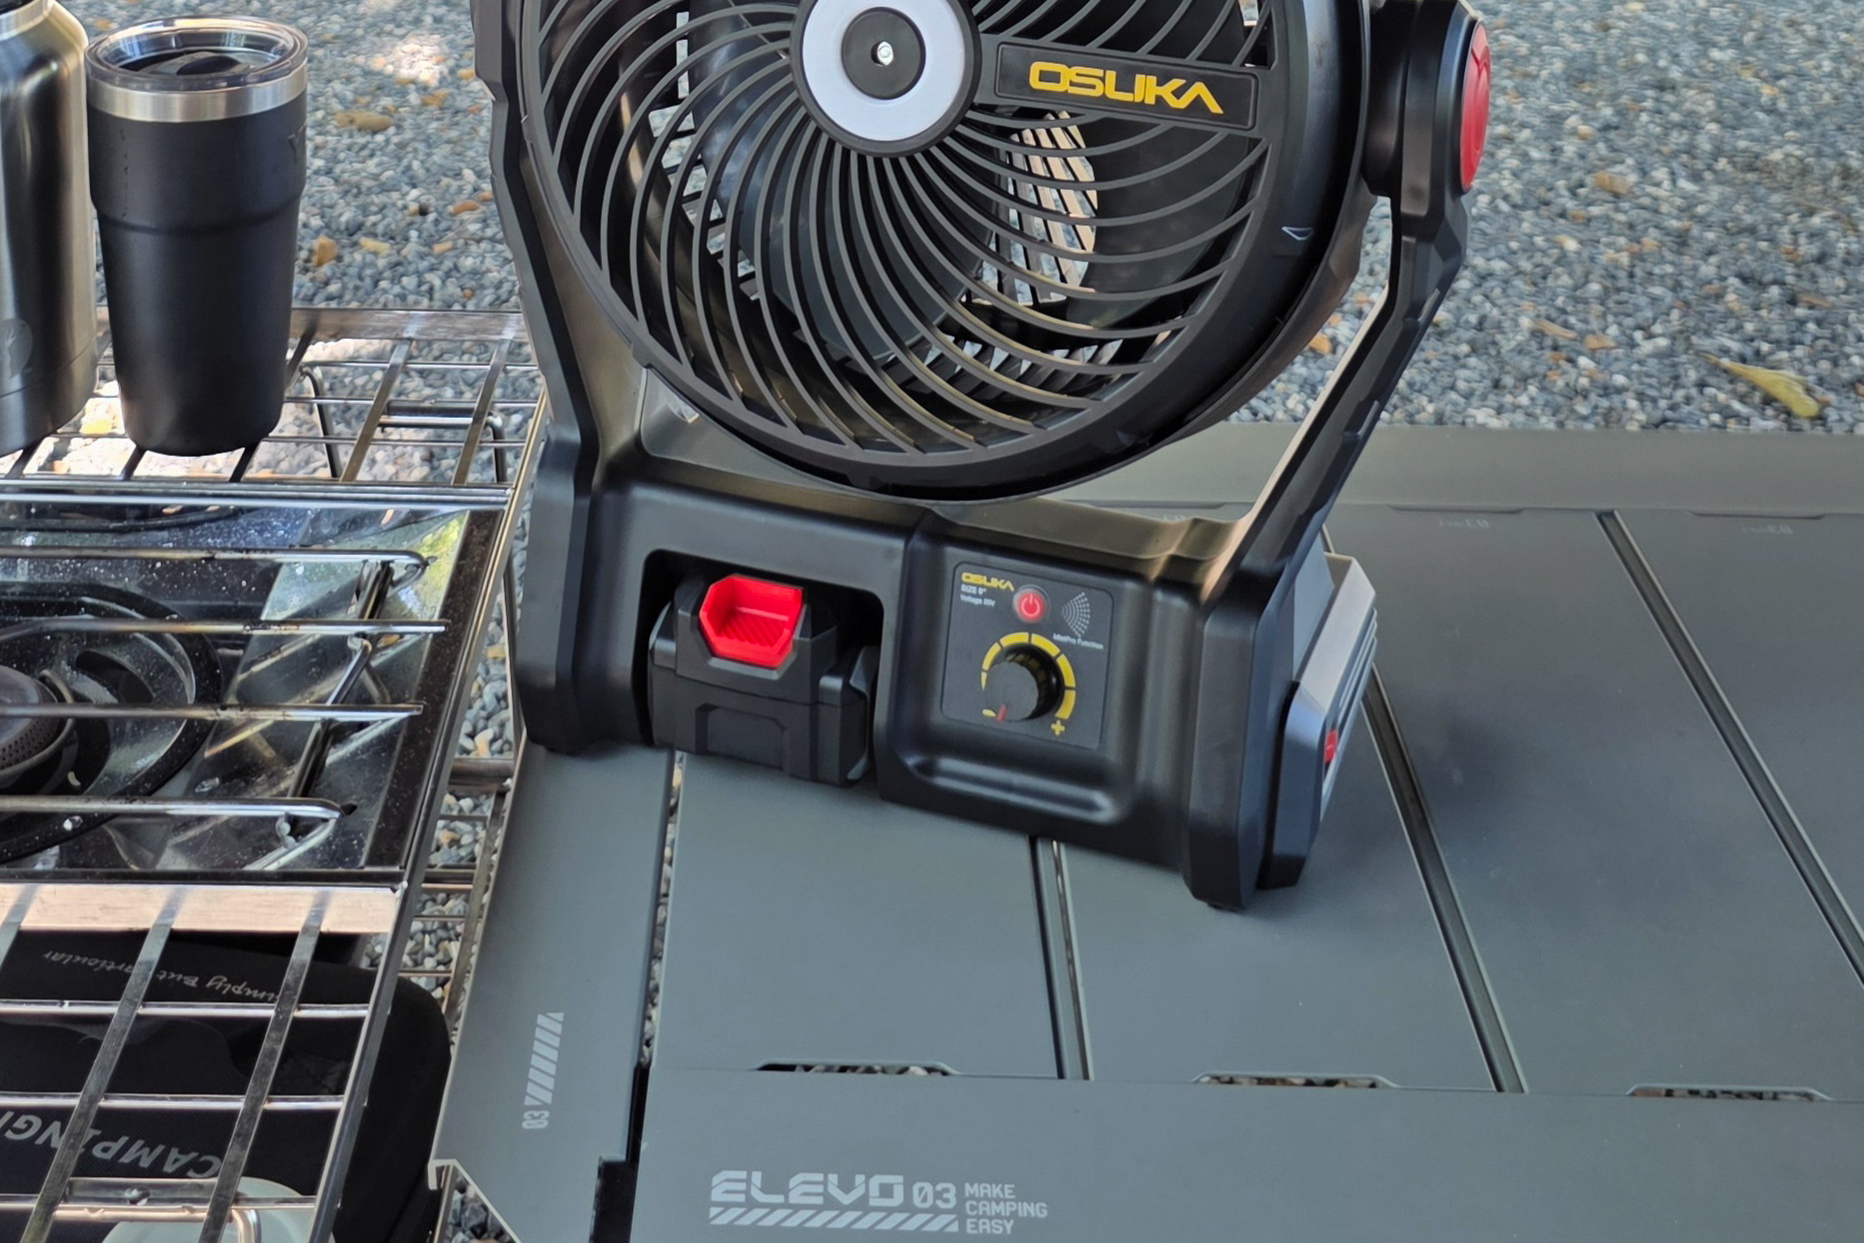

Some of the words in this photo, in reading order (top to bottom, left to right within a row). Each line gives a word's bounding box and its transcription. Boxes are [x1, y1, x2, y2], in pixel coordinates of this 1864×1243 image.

[1029, 61, 1224, 115] OSUKA
[961, 572, 1015, 592] OSUKA
[43, 950, 134, 973] articular
[158, 969, 199, 987] But
[206, 975, 279, 1003] imply
[521, 1110, 550, 1130] 03
[710, 1170, 904, 1207] ELEVO
[911, 1181, 957, 1209] 03
[964, 1182, 1016, 1199] MAKE
[964, 1200, 1048, 1218] CAMPING
[965, 1218, 1015, 1234] EASY
